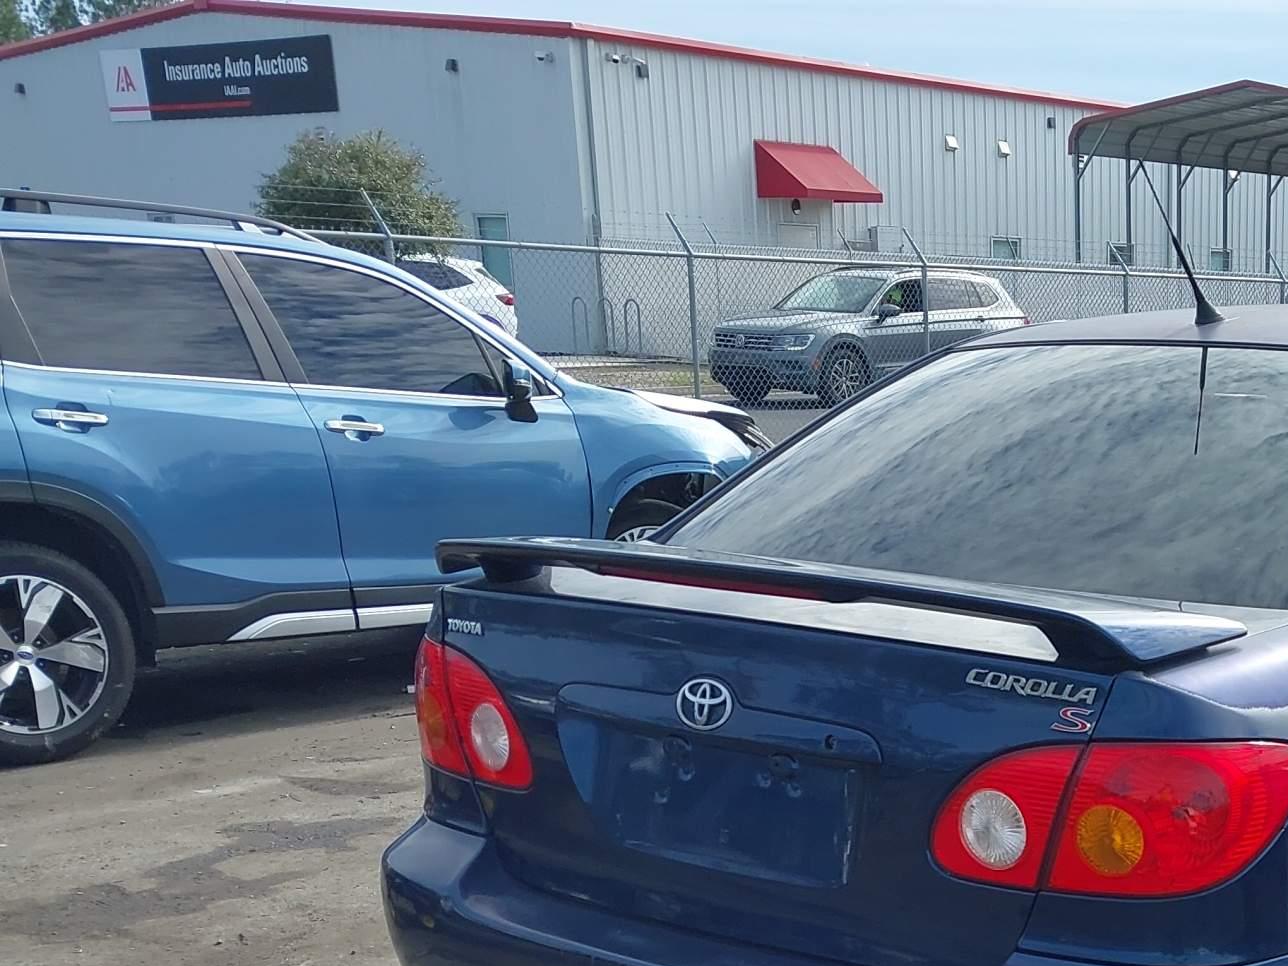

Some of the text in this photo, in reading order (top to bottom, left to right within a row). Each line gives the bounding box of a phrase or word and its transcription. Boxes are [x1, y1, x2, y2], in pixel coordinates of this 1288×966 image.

[164, 52, 309, 81] Insurance Auto Auctions
[447, 618, 482, 635] TOYOTA
[965, 668, 1097, 704] COROLLA
[1050, 707, 1096, 734] S
